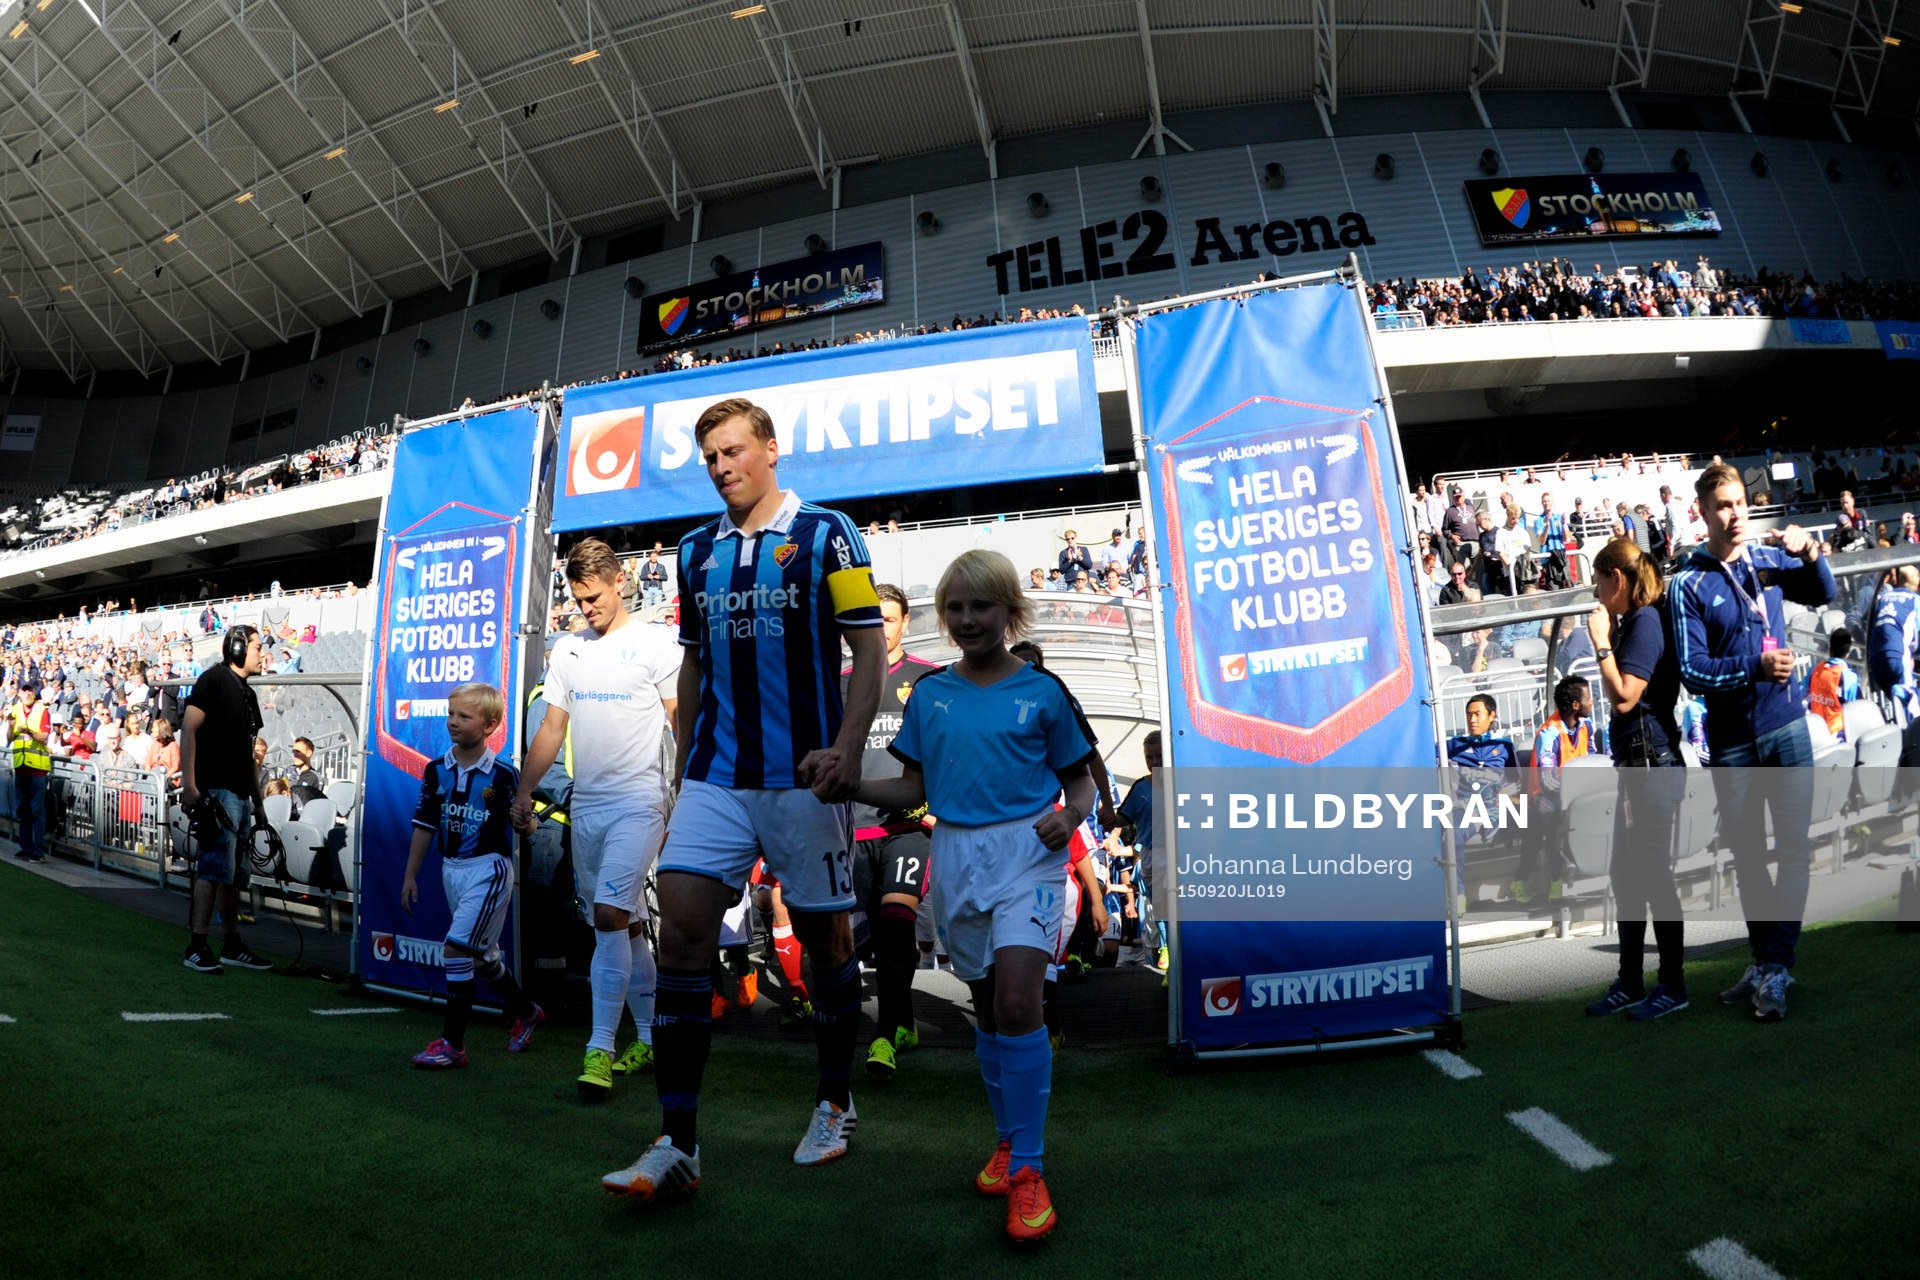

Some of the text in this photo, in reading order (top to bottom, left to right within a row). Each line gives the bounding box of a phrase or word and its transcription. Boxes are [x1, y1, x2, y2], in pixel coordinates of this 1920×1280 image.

[1539, 192, 1699, 215] STOCKHOLM
[986, 209, 1377, 295] TELE2 Arena
[696, 264, 865, 320] STOCKHOLM
[1295, 437, 1307, 451] IN
[1228, 465, 1317, 508] HELA
[1193, 497, 1363, 554] SVERIGES
[421, 559, 473, 589] HELA
[1194, 537, 1374, 595] FOTBOLLS
[396, 588, 496, 622] SVERIGES
[694, 583, 800, 617] Prioritet
[1231, 584, 1348, 632] KLUBB
[390, 621, 497, 653] FOTBOLLS
[707, 615, 785, 643] Finans
[406, 655, 475, 683] KLUBB
[1250, 638, 1366, 675] STRYKTIPSET
[575, 690, 633, 702] Rörläggaren
[440, 799, 491, 822] rioritet
[822, 850, 852, 897] 13
[896, 856, 920, 885] 12
[1251, 962, 1428, 1009] STRYKTIPSET
